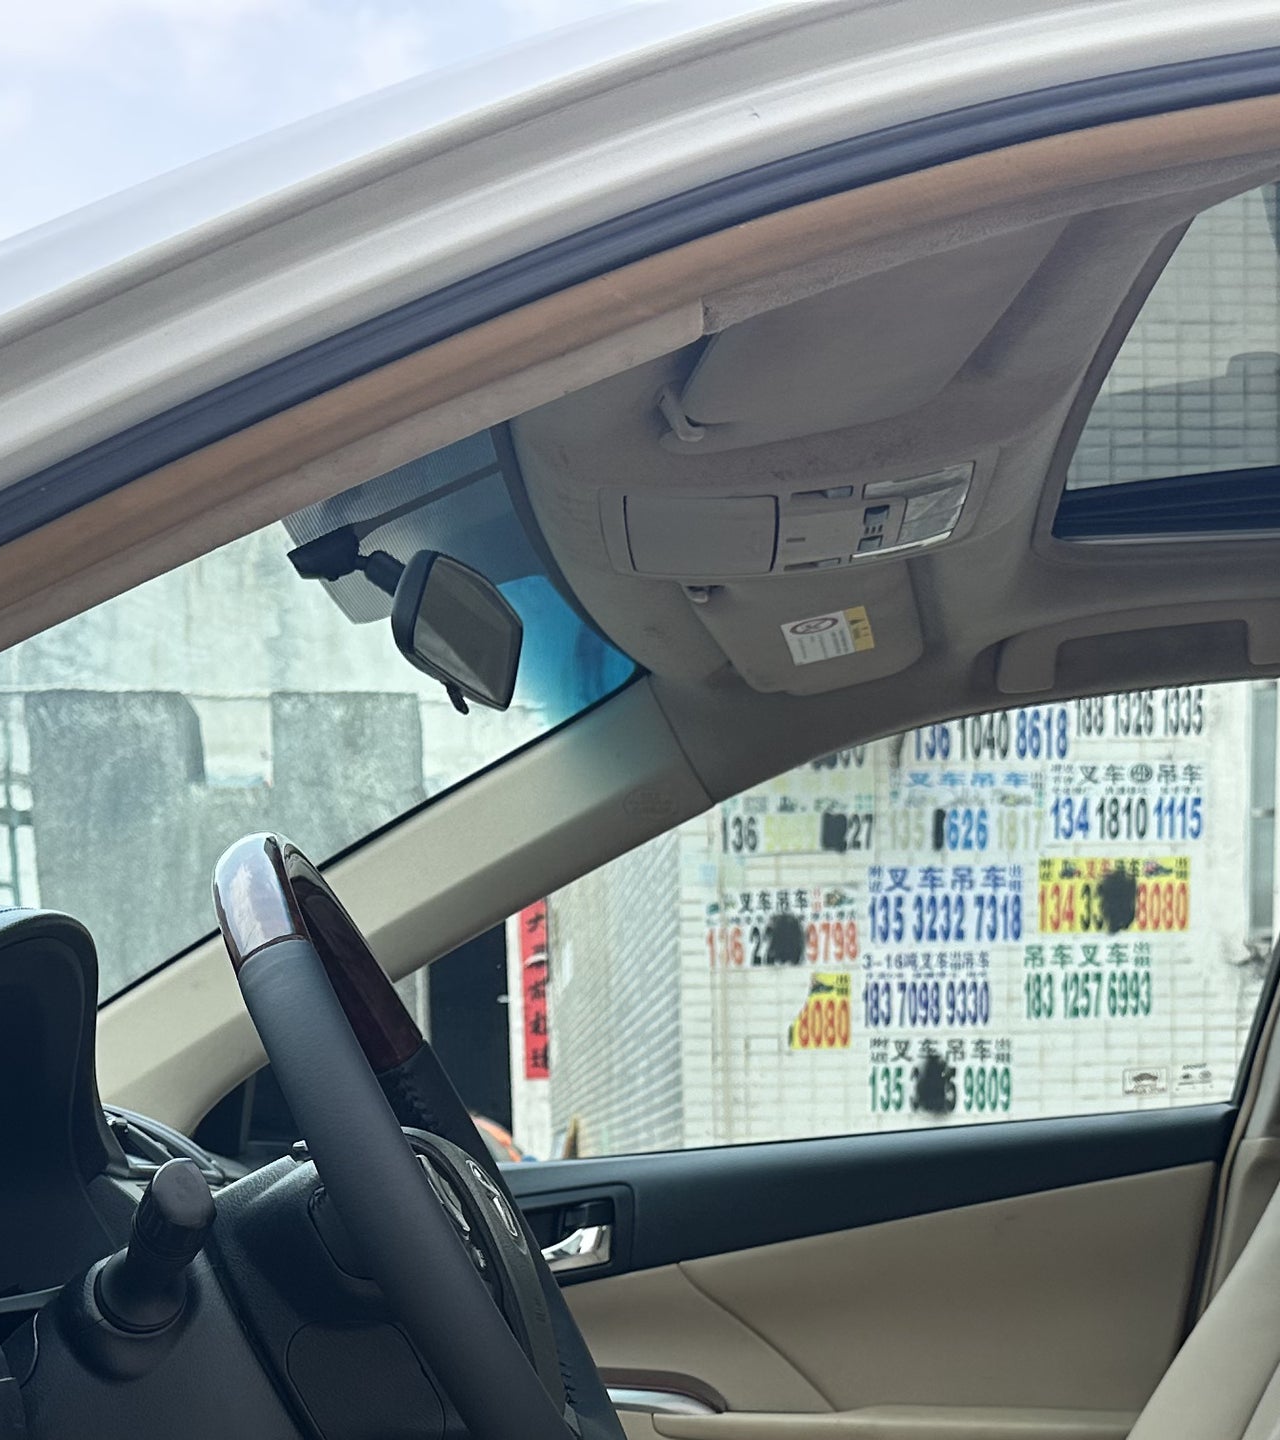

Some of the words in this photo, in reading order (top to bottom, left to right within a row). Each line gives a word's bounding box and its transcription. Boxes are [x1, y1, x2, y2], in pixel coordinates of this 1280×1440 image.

[958, 710, 1010, 760] 1040
[1016, 707, 1068, 760] 8618
[1075, 697, 1104, 737] 188
[1112, 690, 1154, 736] 1326
[1162, 688, 1204, 735] 1335
[722, 815, 758, 853] 136
[1050, 797, 1090, 840] 134
[1096, 797, 1147, 840] 1810
[1153, 797, 1204, 840] 1115
[885, 865, 1007, 893] 叉车吊车
[869, 894, 904, 943] 135
[912, 894, 965, 942] 3232
[973, 894, 1023, 942] 7318
[1039, 883, 1075, 932] 134
[1136, 882, 1189, 932] 8080
[806, 921, 859, 964] 9798
[1024, 943, 1129, 969] 吊车叉车
[862, 981, 892, 1027] 183
[897, 981, 940, 1027] 7098
[946, 981, 990, 1026] 9330
[1024, 972, 1054, 1019] 183
[1062, 971, 1102, 1019] 1257
[1107, 970, 1151, 1017] 6993
[869, 1065, 904, 1112] 135
[964, 1065, 1011, 1112] 9809
